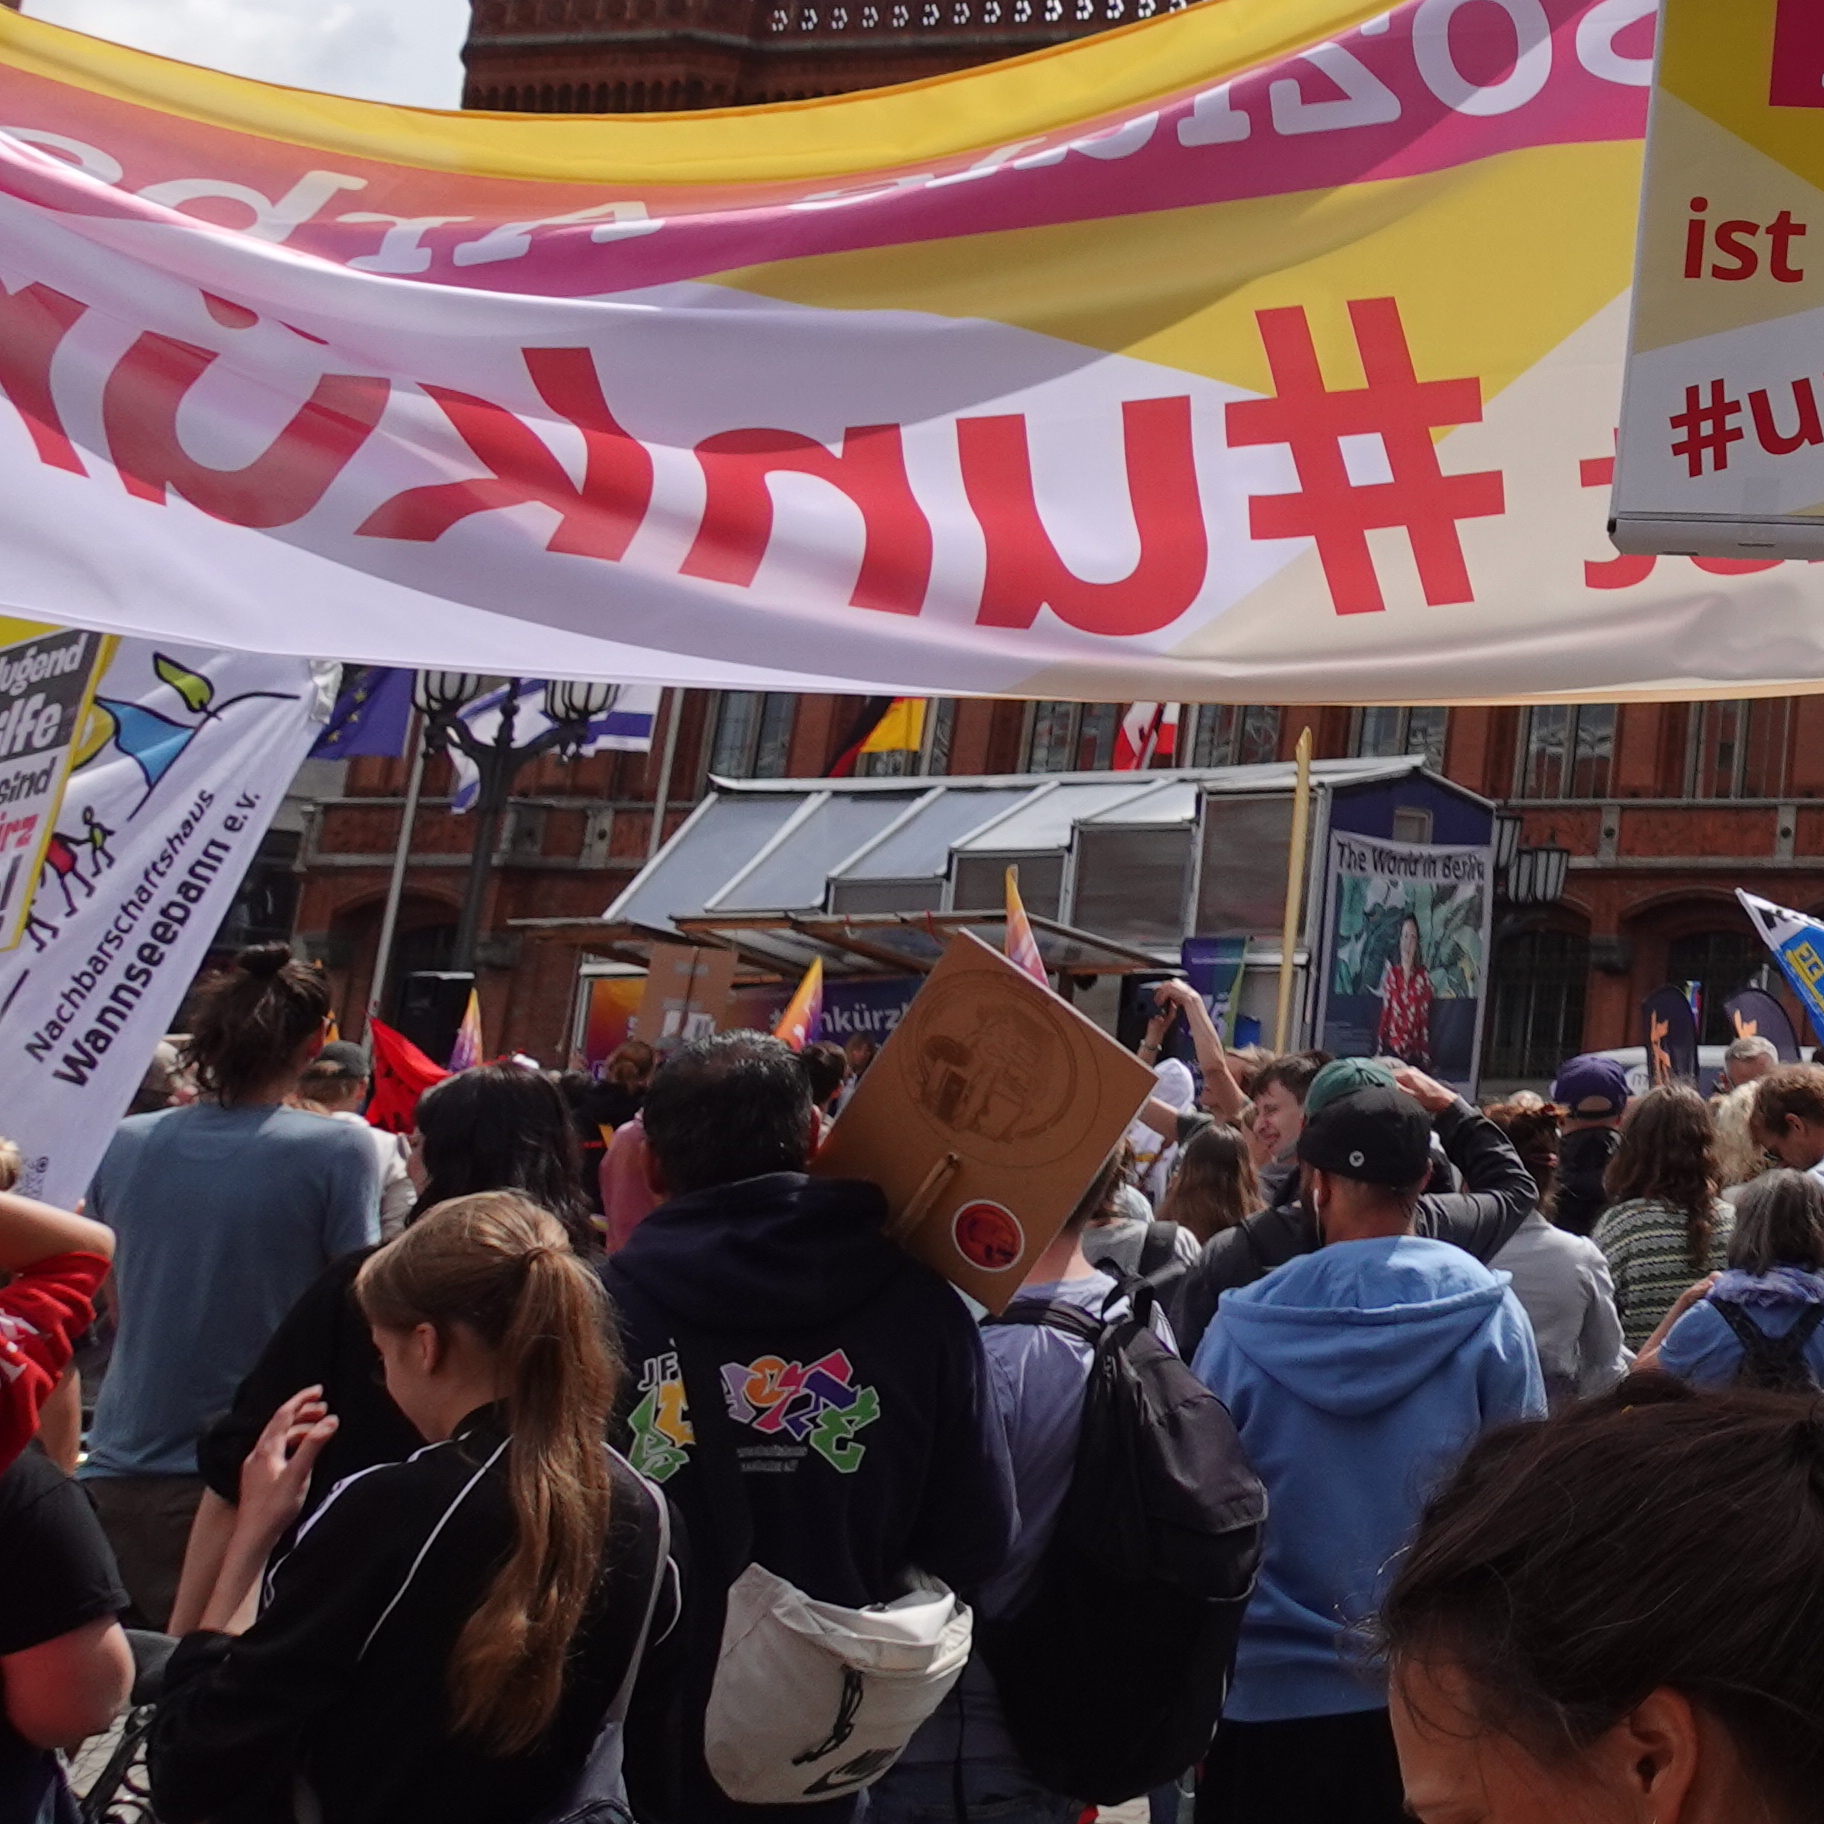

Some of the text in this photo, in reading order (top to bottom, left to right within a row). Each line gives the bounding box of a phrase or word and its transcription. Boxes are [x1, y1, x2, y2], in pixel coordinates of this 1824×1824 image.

[1683, 195, 1807, 283] ist
[1338, 841, 1367, 872] The
[1421, 851, 1438, 879] in
[1442, 853, 1486, 882] Berlin
[24, 789, 215, 1063] Nachbarschaftshaus
